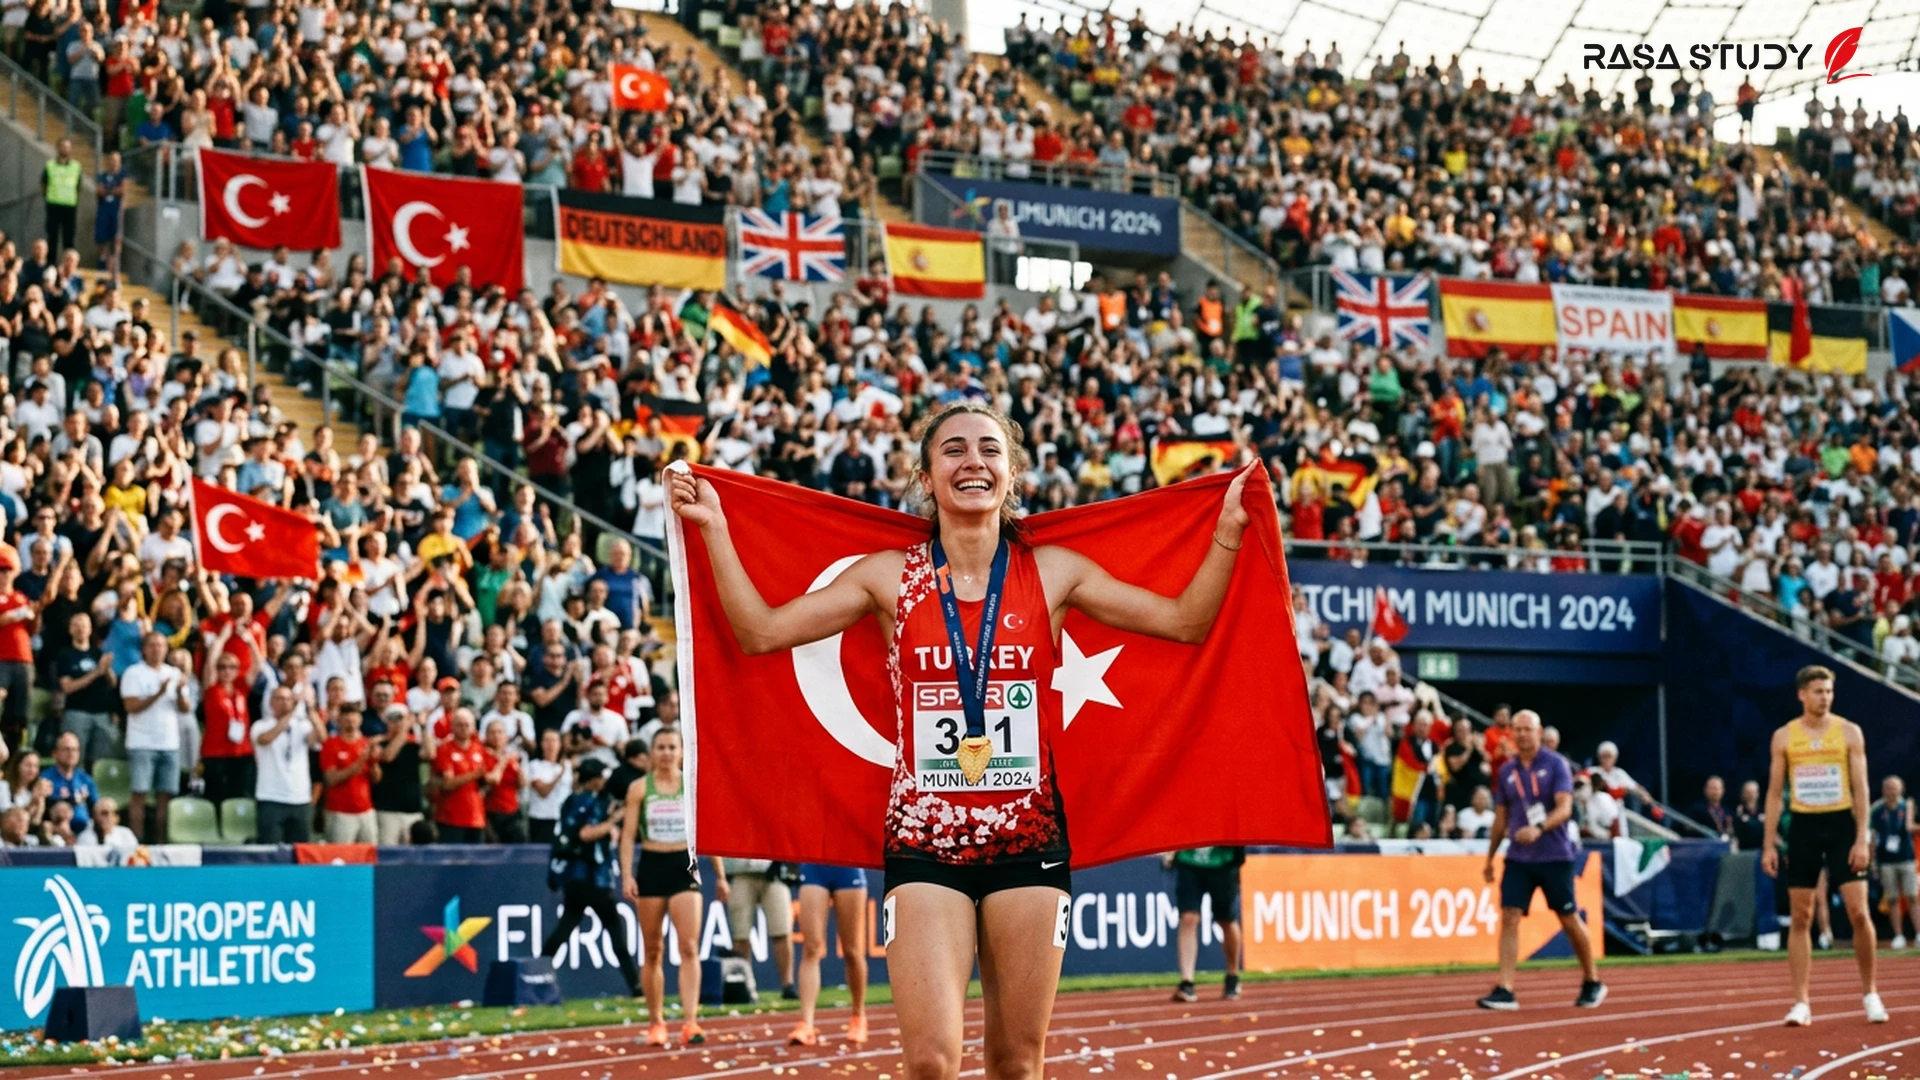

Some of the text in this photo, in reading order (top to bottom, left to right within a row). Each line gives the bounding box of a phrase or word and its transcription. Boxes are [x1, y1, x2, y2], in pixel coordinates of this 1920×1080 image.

[566, 213, 722, 255] DEUTSCHLAND
[1110, 209, 1162, 236] 2024
[1562, 305, 1666, 340] SPAIN
[1425, 590, 1551, 629] MUNICH
[1559, 595, 1636, 631] 2024
[919, 687, 1002, 707] SPR
[935, 716, 1012, 755] 31
[994, 771, 1032, 786] 2024
[127, 900, 315, 943] EUROPEAN
[1253, 887, 1498, 943] MUNICH 2024
[125, 943, 316, 989] ATHLETICS
